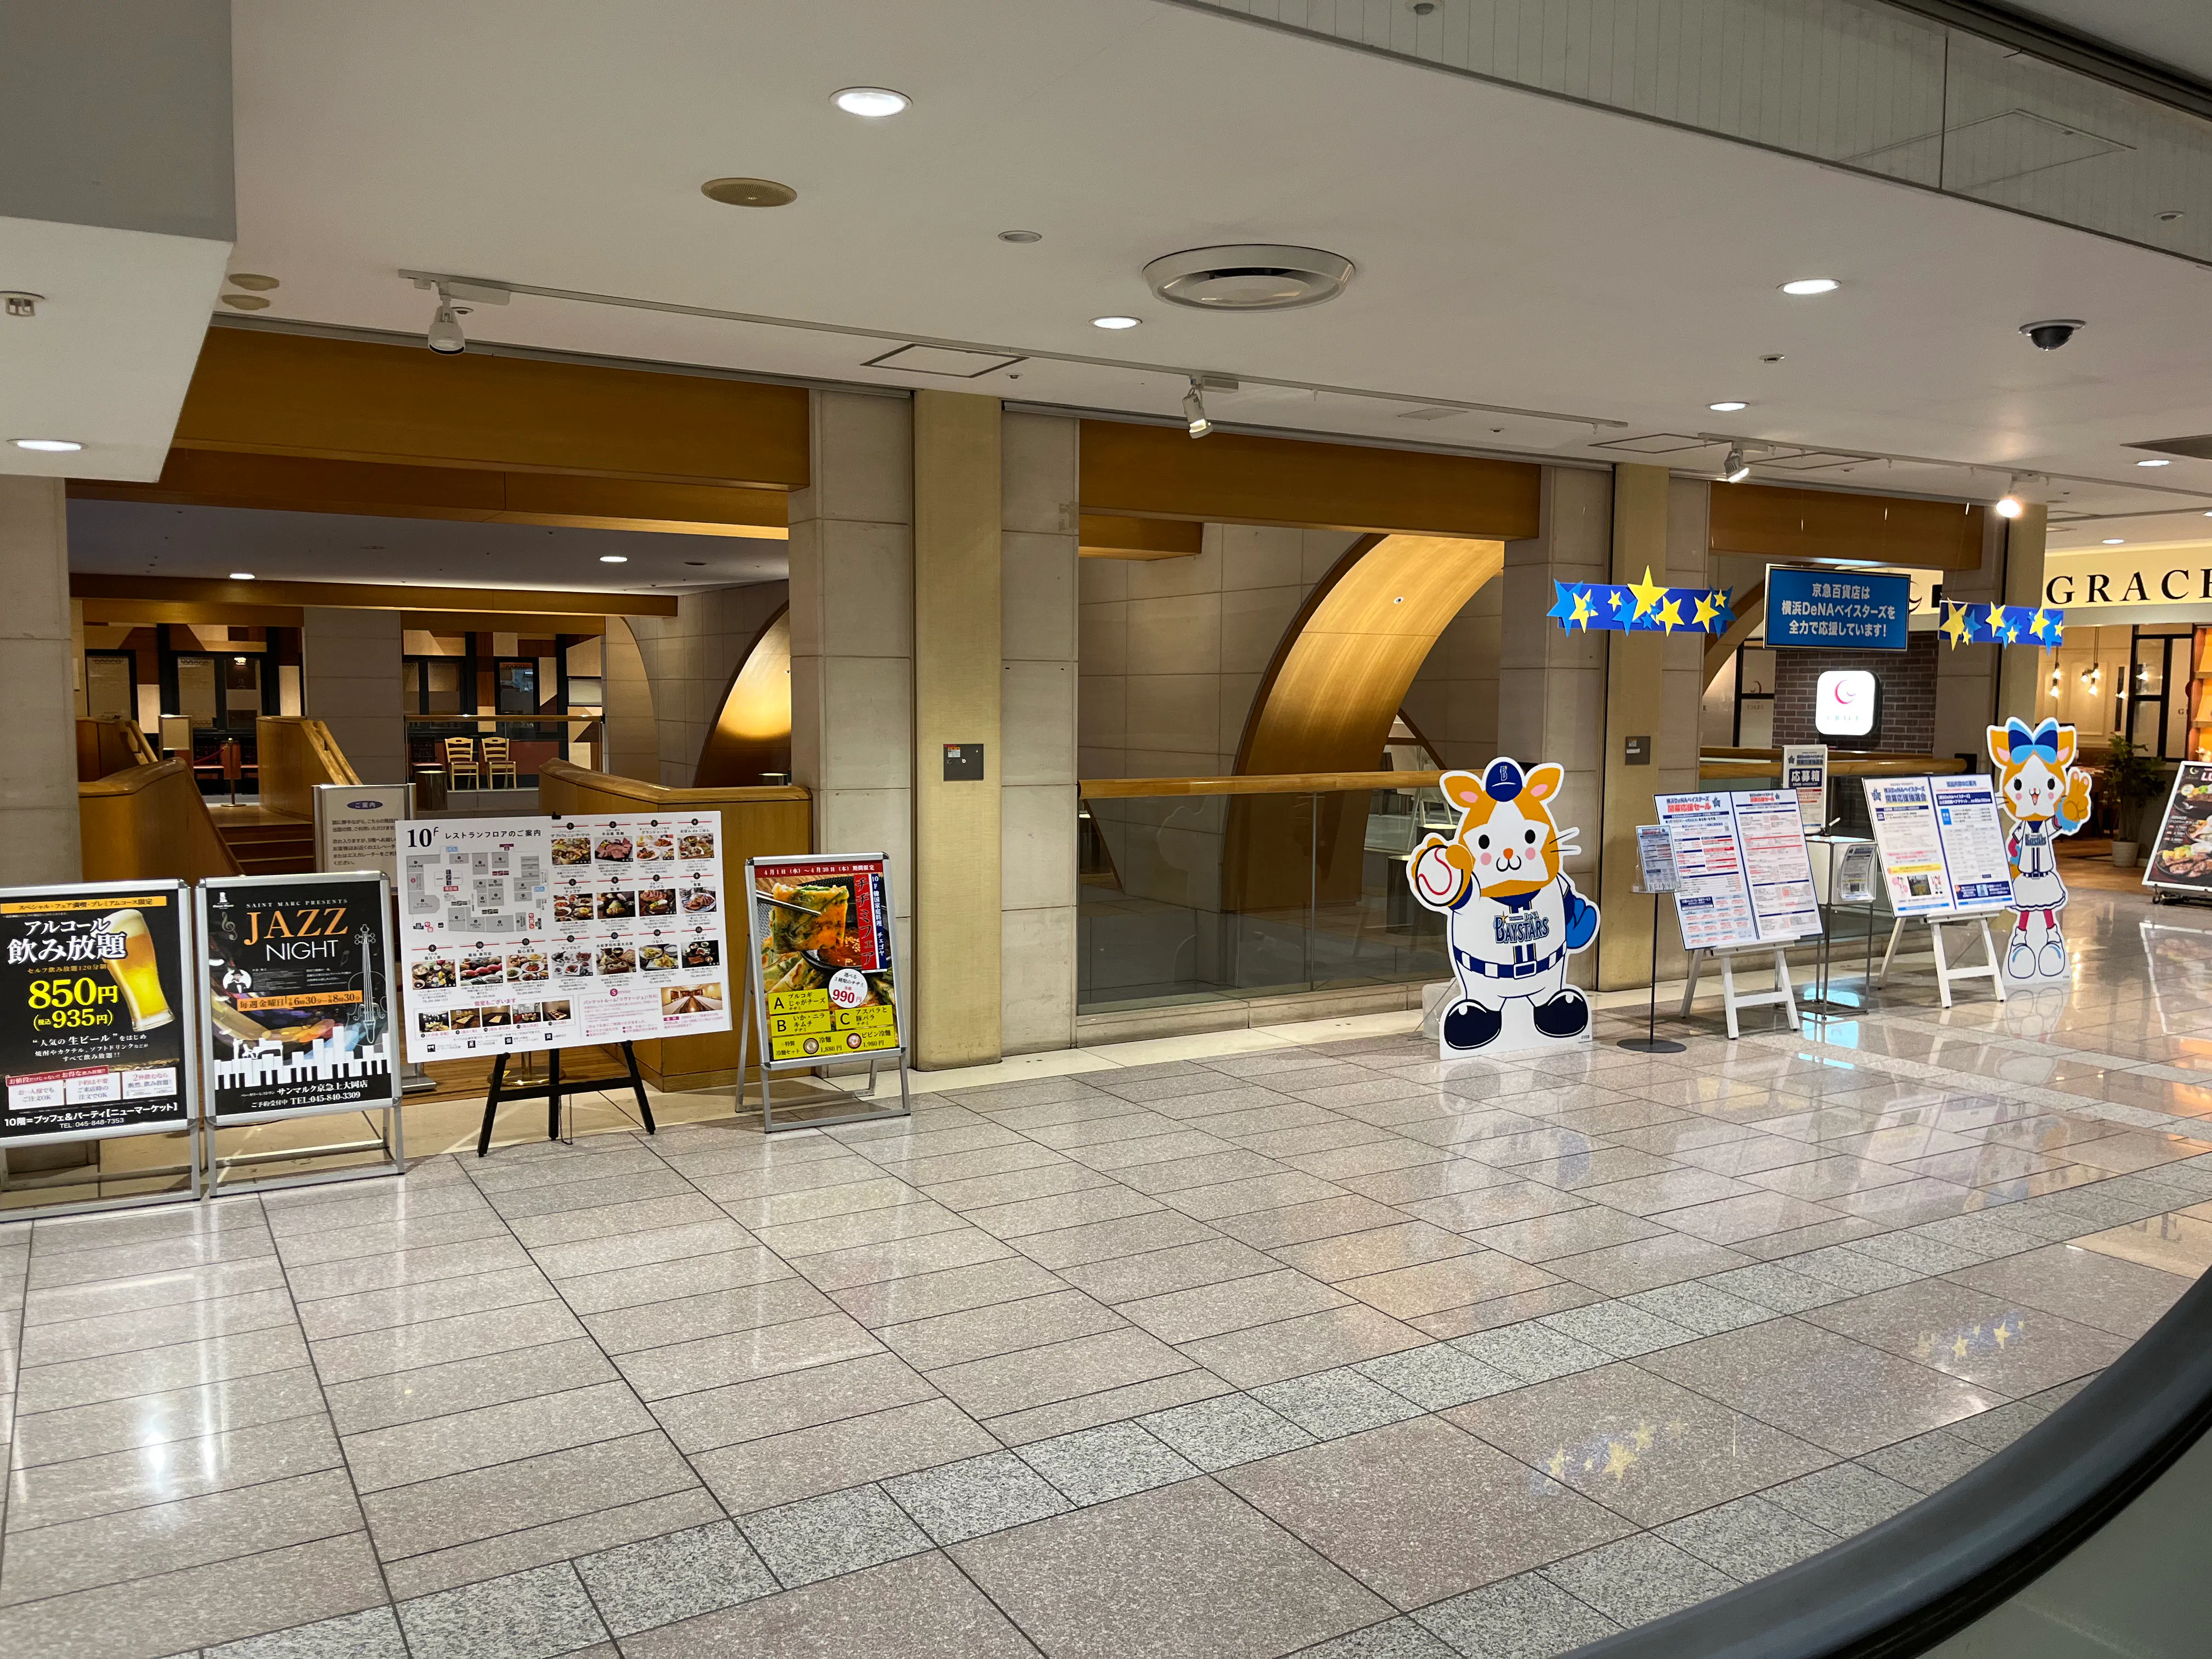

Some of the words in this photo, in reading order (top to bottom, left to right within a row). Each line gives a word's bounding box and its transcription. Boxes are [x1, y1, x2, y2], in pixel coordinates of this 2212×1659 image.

[1812, 583, 1870, 600] 京急百貨店は
[1781, 600, 1895, 620] 横浜DeNAベイスターズを
[1788, 620, 1887, 637] 全力で応援しています!
[445, 829, 541, 839] レストランフロアのご案内
[24, 918, 112, 936] アルコール
[244, 907, 349, 946] JAZZ
[1493, 915, 1550, 944] BAYSTARS
[7, 932, 126, 964] 飲み放題
[266, 939, 339, 961] NIGHT
[28, 977, 119, 1009] 850円
[789, 997, 826, 1006] じゃがチーズ
[832, 989, 862, 1003] 990円
[774, 997, 785, 1010] A
[777, 1019, 787, 1032] B
[840, 1013, 850, 1025] C
